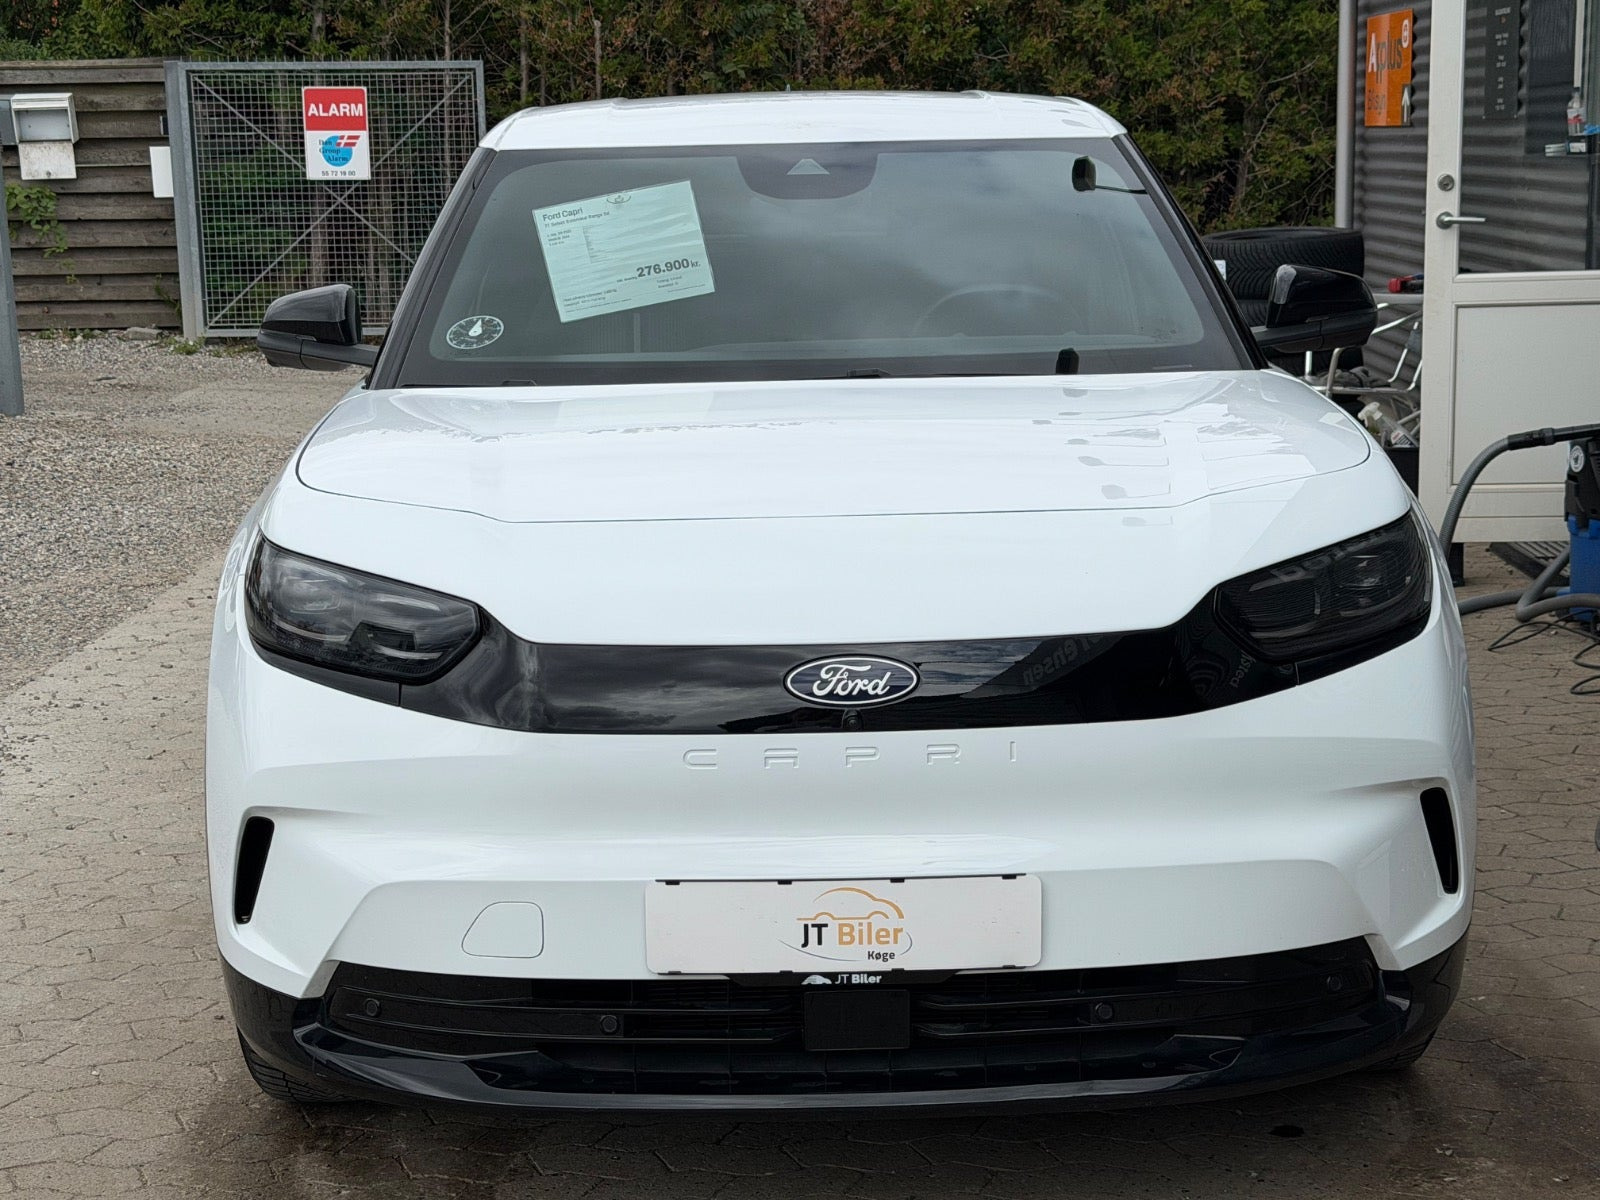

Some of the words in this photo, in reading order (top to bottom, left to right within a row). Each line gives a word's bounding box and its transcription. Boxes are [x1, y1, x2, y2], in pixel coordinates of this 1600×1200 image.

[308, 103, 364, 117] ALARM
[542, 211, 561, 222] Ford
[561, 207, 584, 218] Capri
[636, 258, 690, 278] 276.900
[690, 260, 701, 268] kr.
[812, 664, 892, 696] Ford
[683, 740, 1017, 769] CAPRI
[801, 923, 829, 948] JT
[838, 922, 903, 945] Biler
[867, 951, 896, 962] Køge
[835, 974, 849, 984] JT
[851, 973, 882, 984] Biler
